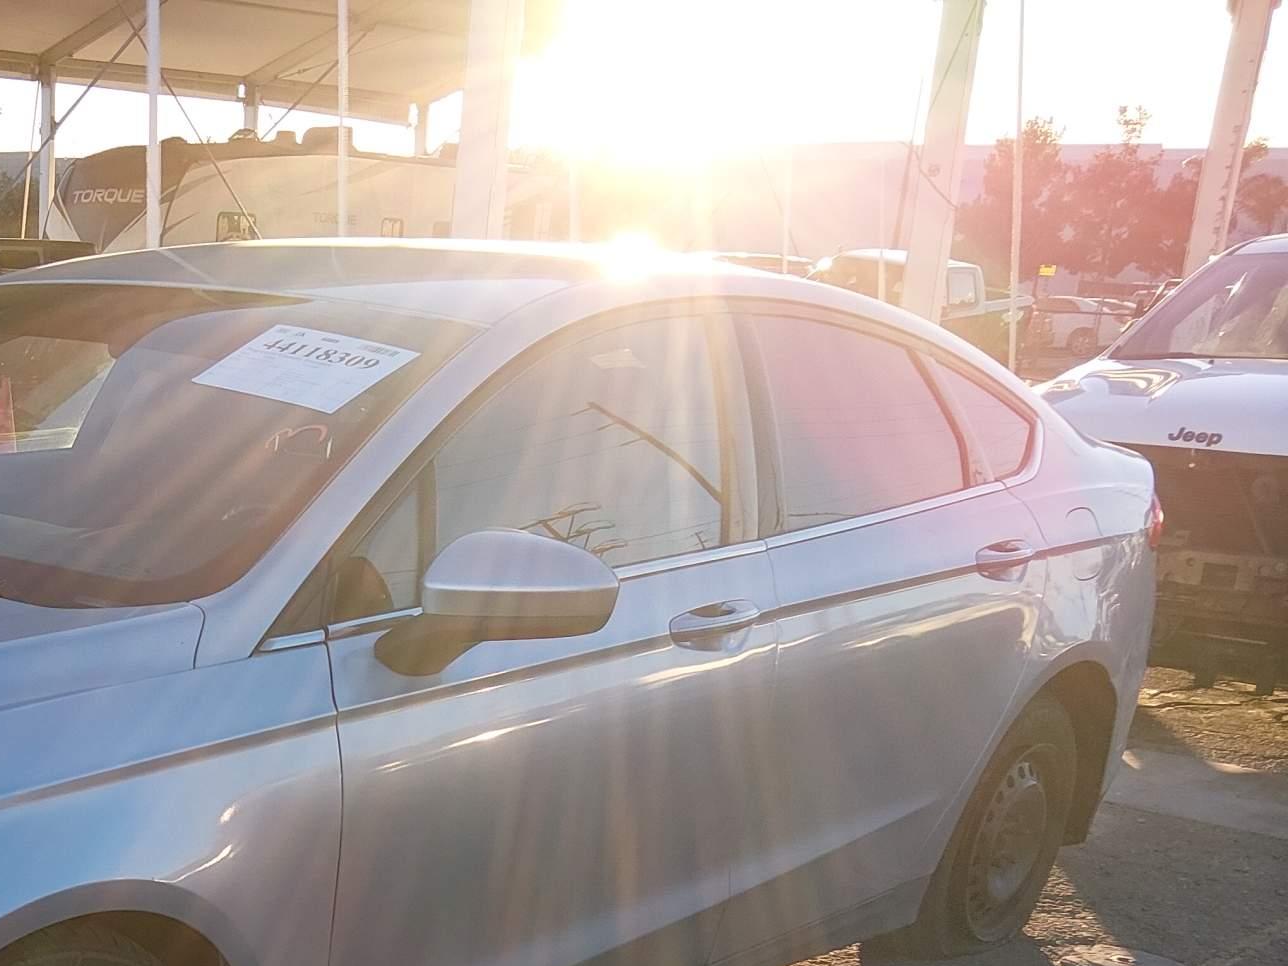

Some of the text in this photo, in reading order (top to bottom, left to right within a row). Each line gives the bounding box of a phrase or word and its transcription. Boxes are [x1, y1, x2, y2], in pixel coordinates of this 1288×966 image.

[72, 188, 145, 204] TORQUE
[264, 338, 380, 370] 44118309
[1167, 426, 1223, 447] Jeep
